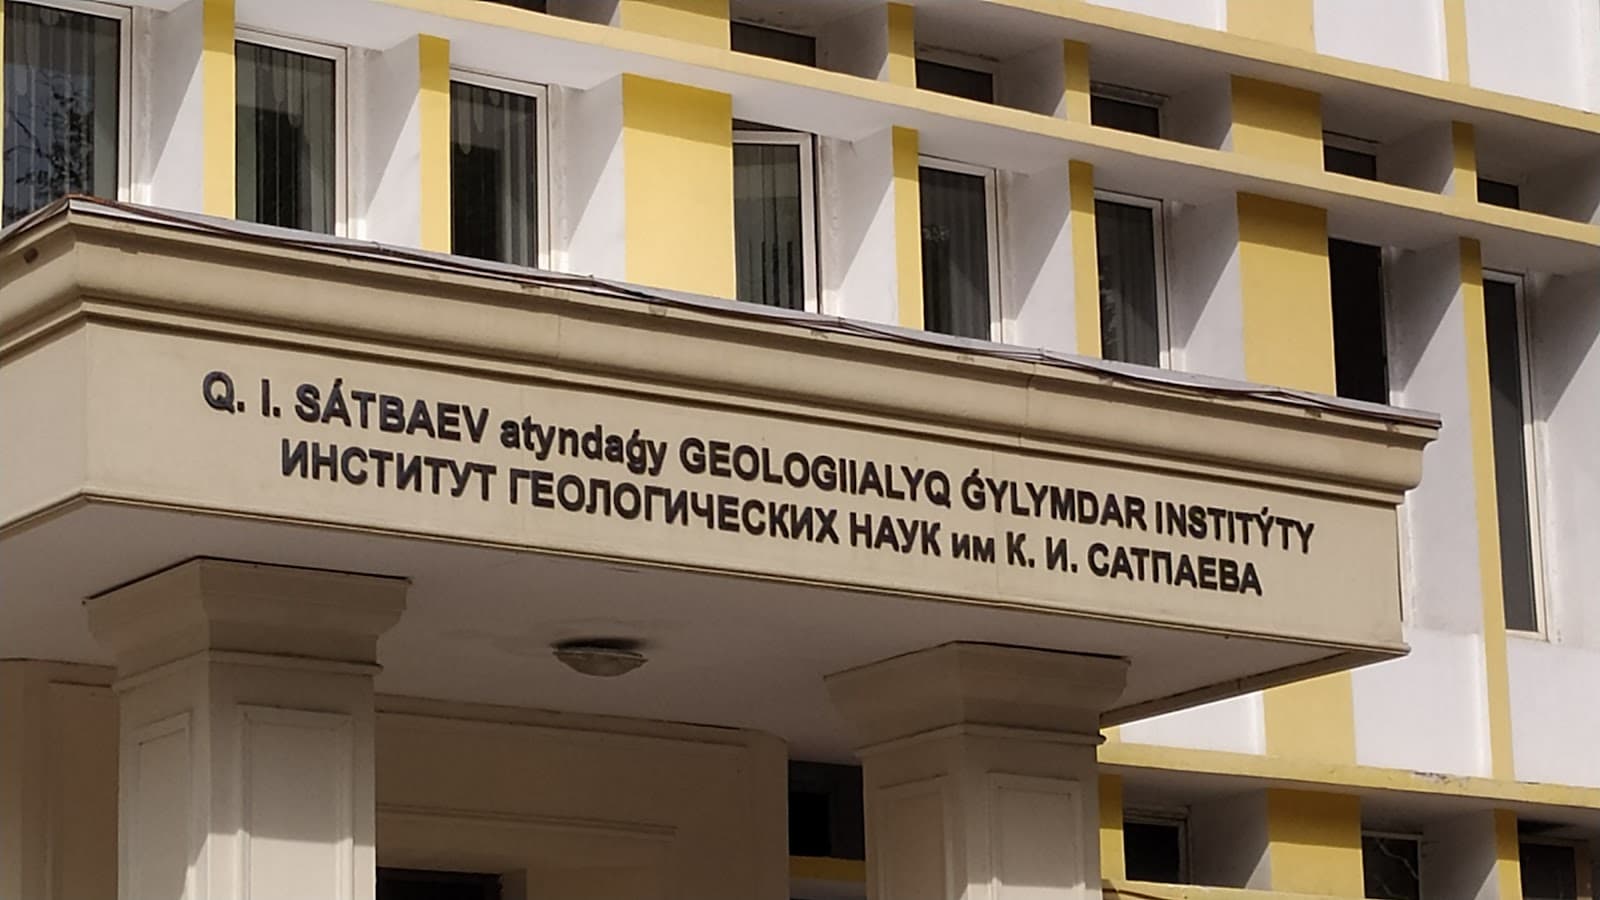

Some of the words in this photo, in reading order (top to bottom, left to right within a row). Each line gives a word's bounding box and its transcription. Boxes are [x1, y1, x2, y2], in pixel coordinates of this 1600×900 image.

[203, 371, 245, 415] Q.
[261, 378, 281, 418] I.
[294, 379, 489, 444] SÁTBAEV
[500, 415, 668, 477] atyndaǵy
[679, 437, 951, 509] GEOLOGIIALYQ
[961, 468, 1148, 532] ǴYLYMDAR
[1155, 501, 1315, 554] INSTITÝTY
[281, 438, 497, 502] ИНСТИТУТ
[509, 467, 840, 545] ГЕОЛОГИЧЕСКИХ
[849, 511, 941, 557] НАУК
[951, 532, 996, 564] им
[1006, 531, 1035, 569] К.
[1045, 536, 1078, 574] И.
[1087, 542, 1263, 597] САТПАЕВА
